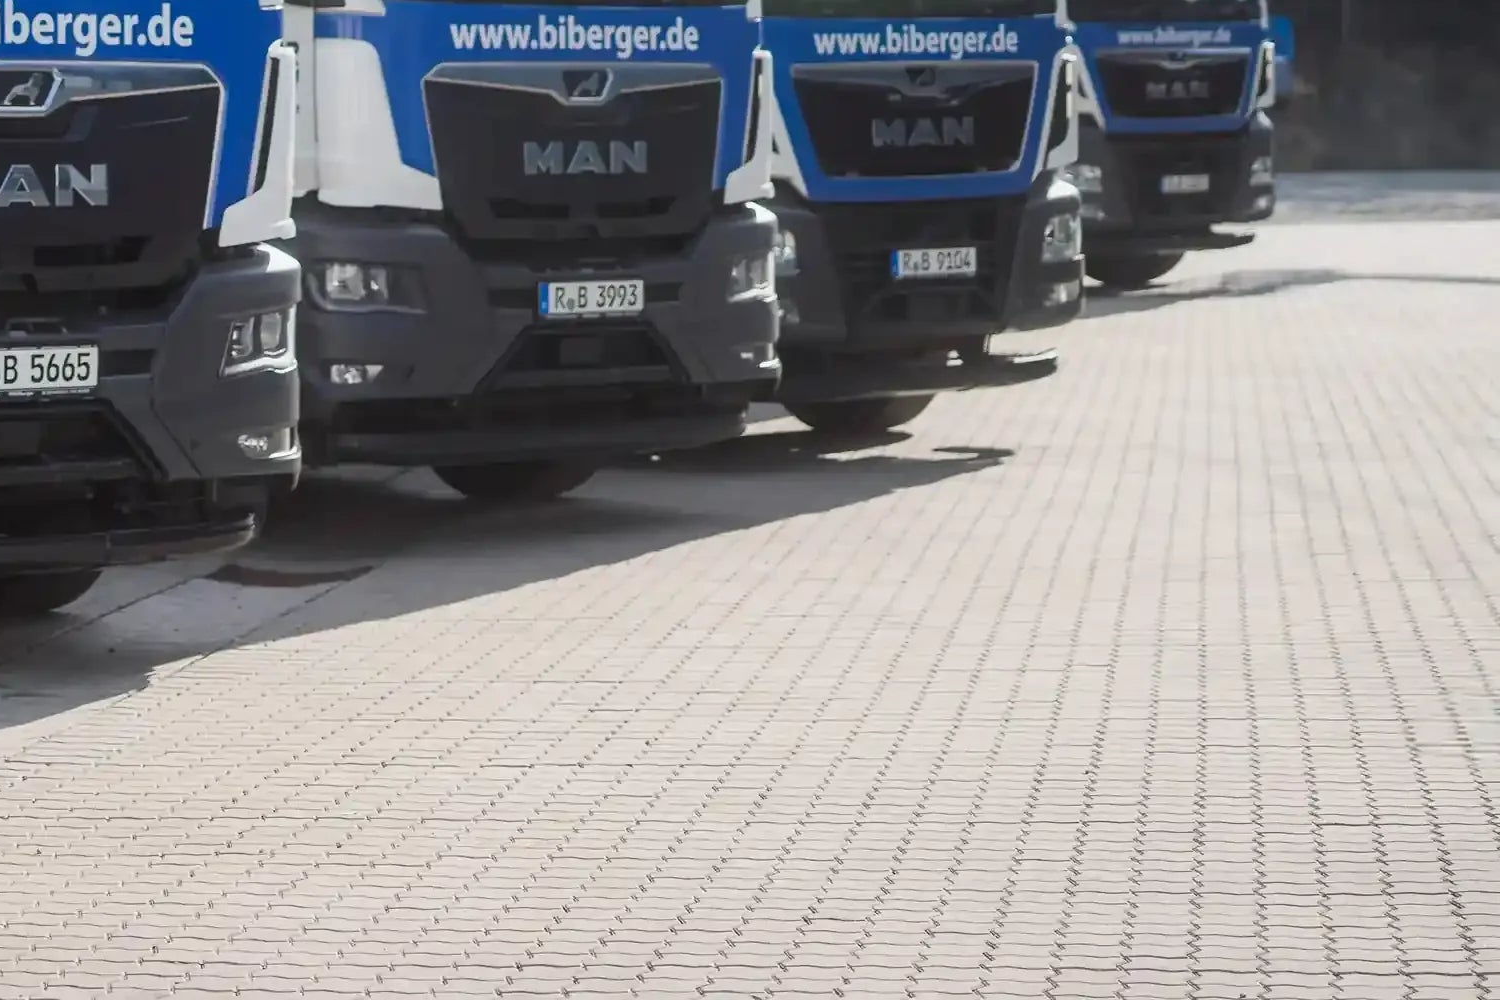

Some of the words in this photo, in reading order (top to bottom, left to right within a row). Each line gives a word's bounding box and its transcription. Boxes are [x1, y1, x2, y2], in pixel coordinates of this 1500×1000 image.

[449, 14, 699, 59] www.biberger.de
[813, 23, 1019, 60] www.biberger.de
[871, 116, 975, 147] MAN
[522, 140, 648, 176] MAN
[555, 286, 566, 310] R
[578, 285, 588, 308] B
[596, 283, 638, 308] 3993
[4, 355, 18, 384] B
[31, 352, 91, 383] 5665
